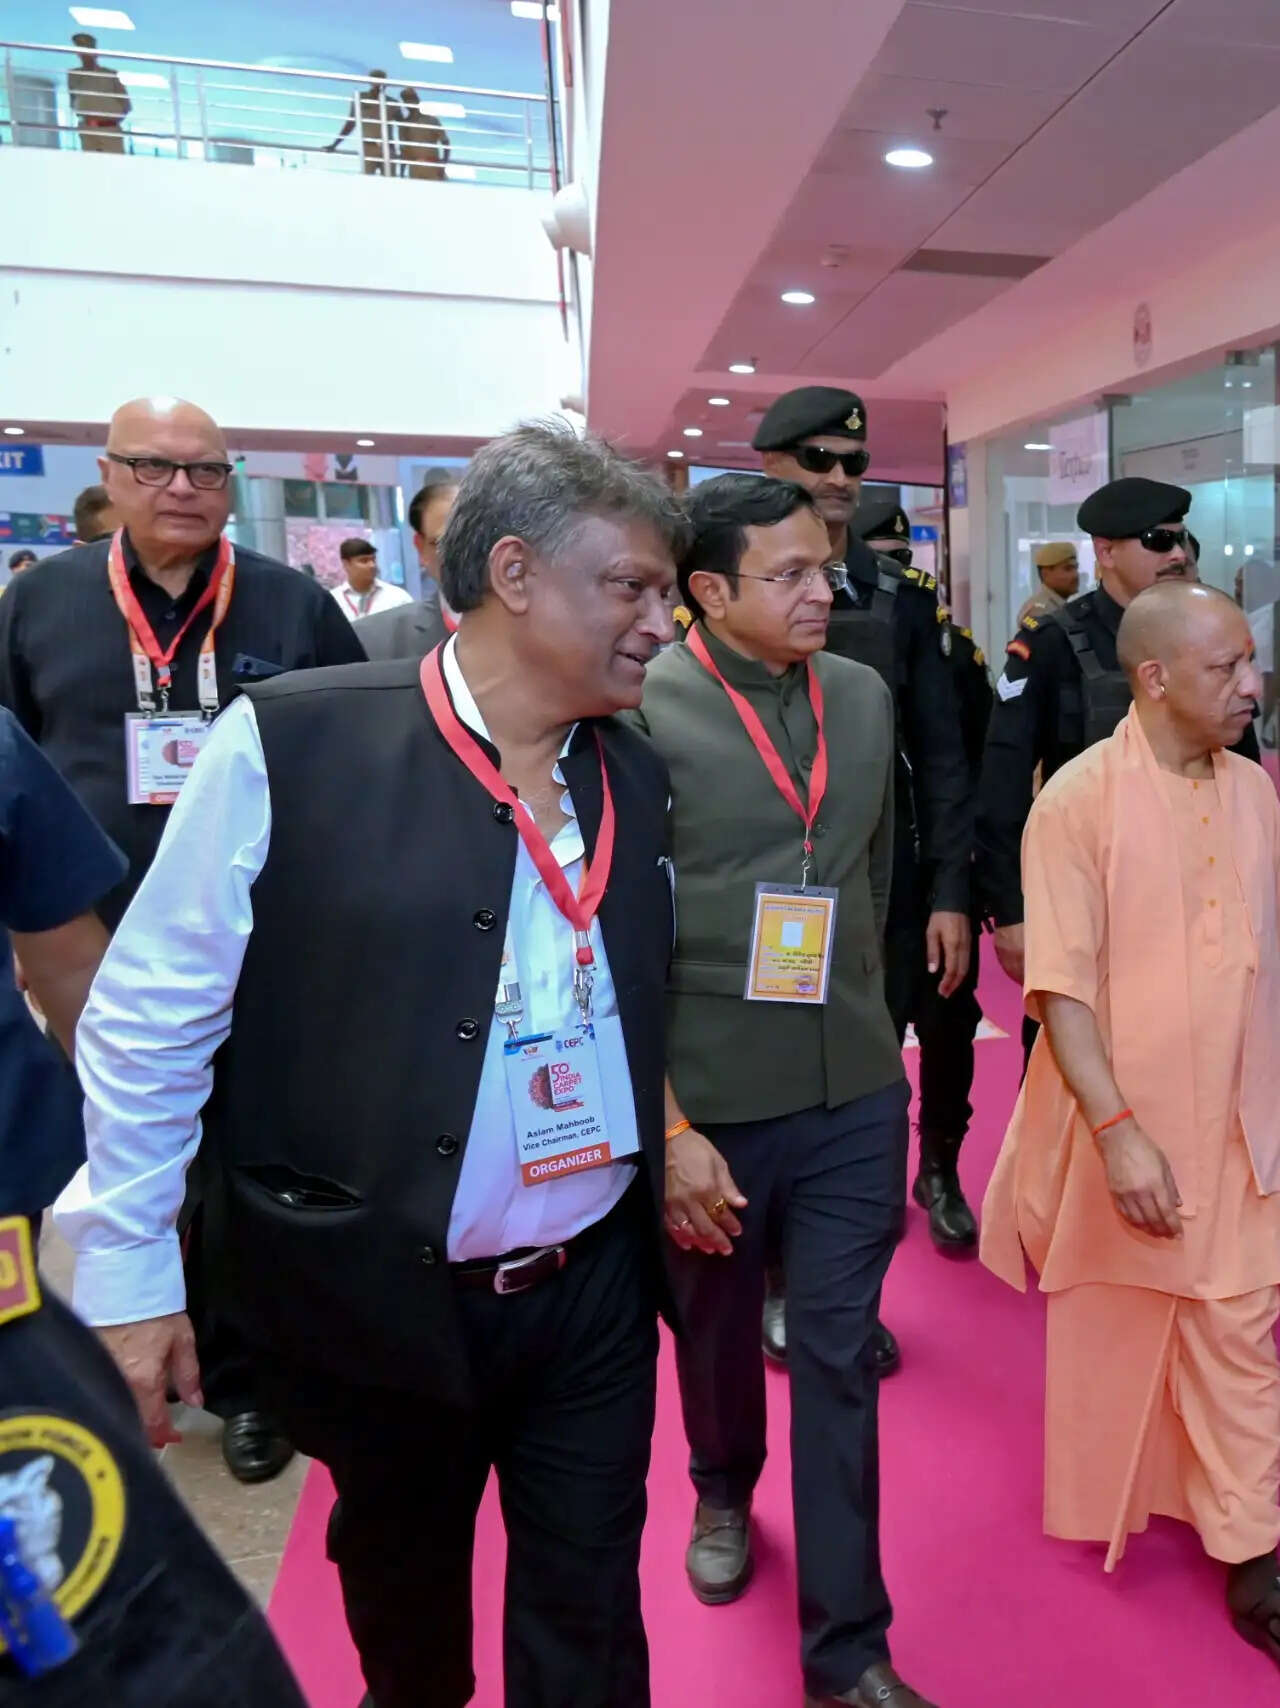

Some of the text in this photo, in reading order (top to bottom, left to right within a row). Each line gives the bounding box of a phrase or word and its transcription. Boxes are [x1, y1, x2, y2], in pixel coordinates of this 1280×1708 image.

[523, 1141, 540, 1152] Vice
[580, 1125, 601, 1137] CEPC
[527, 1115, 595, 1139] Aslam Mahboob
[529, 1148, 603, 1178] ORGANIZER
